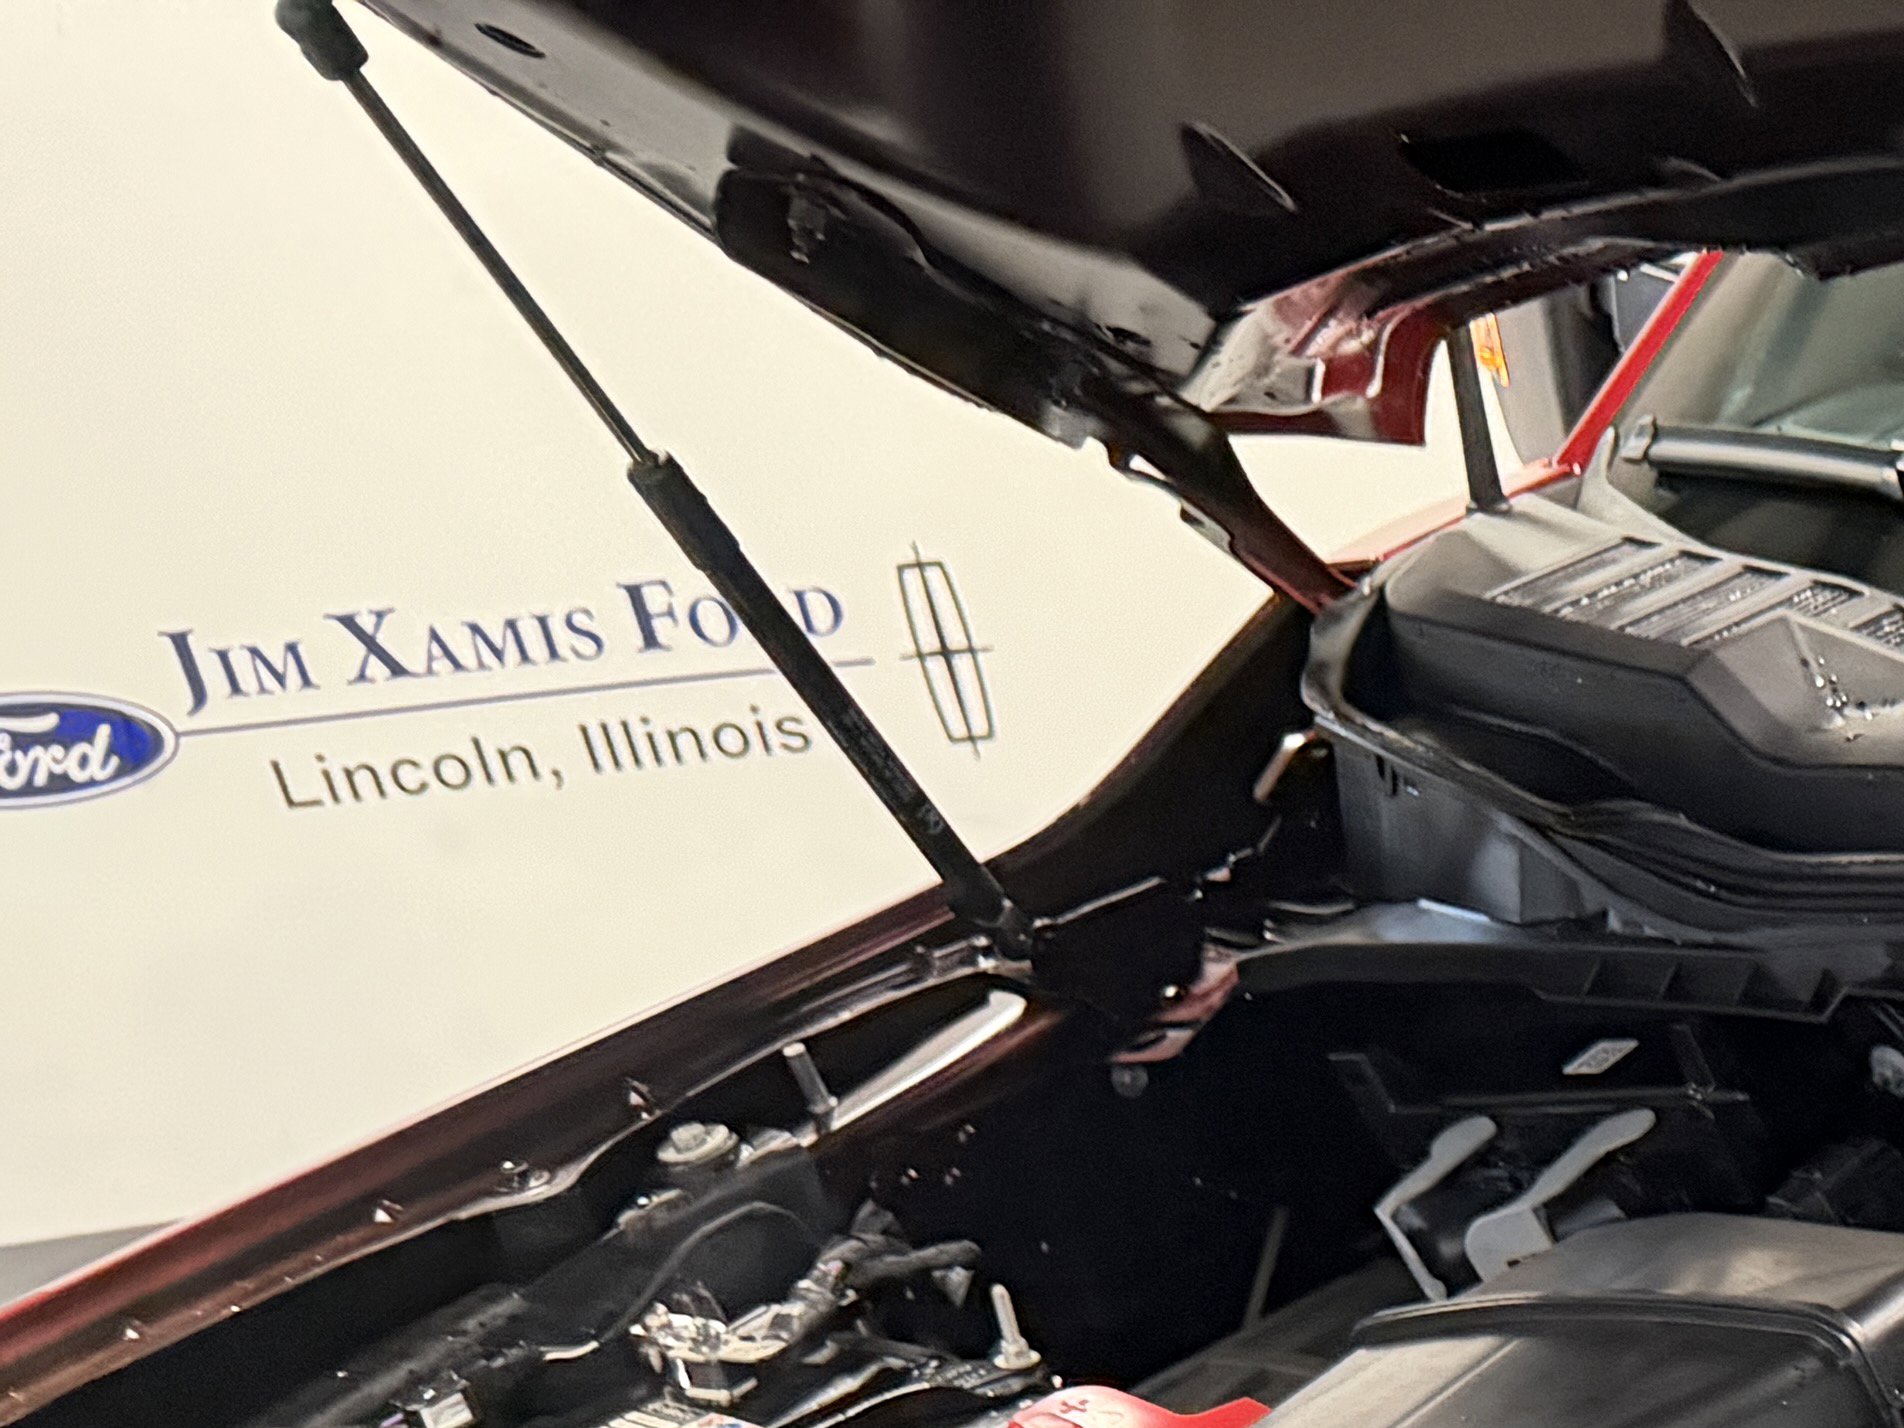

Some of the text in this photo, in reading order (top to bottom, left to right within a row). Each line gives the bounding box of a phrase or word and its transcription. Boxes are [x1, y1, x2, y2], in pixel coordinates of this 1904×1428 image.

[159, 578, 848, 718] JIM XAMIS FOD
[0, 712, 120, 790] ord
[270, 736, 567, 812] Lincoln,
[576, 702, 812, 777] Illinois
